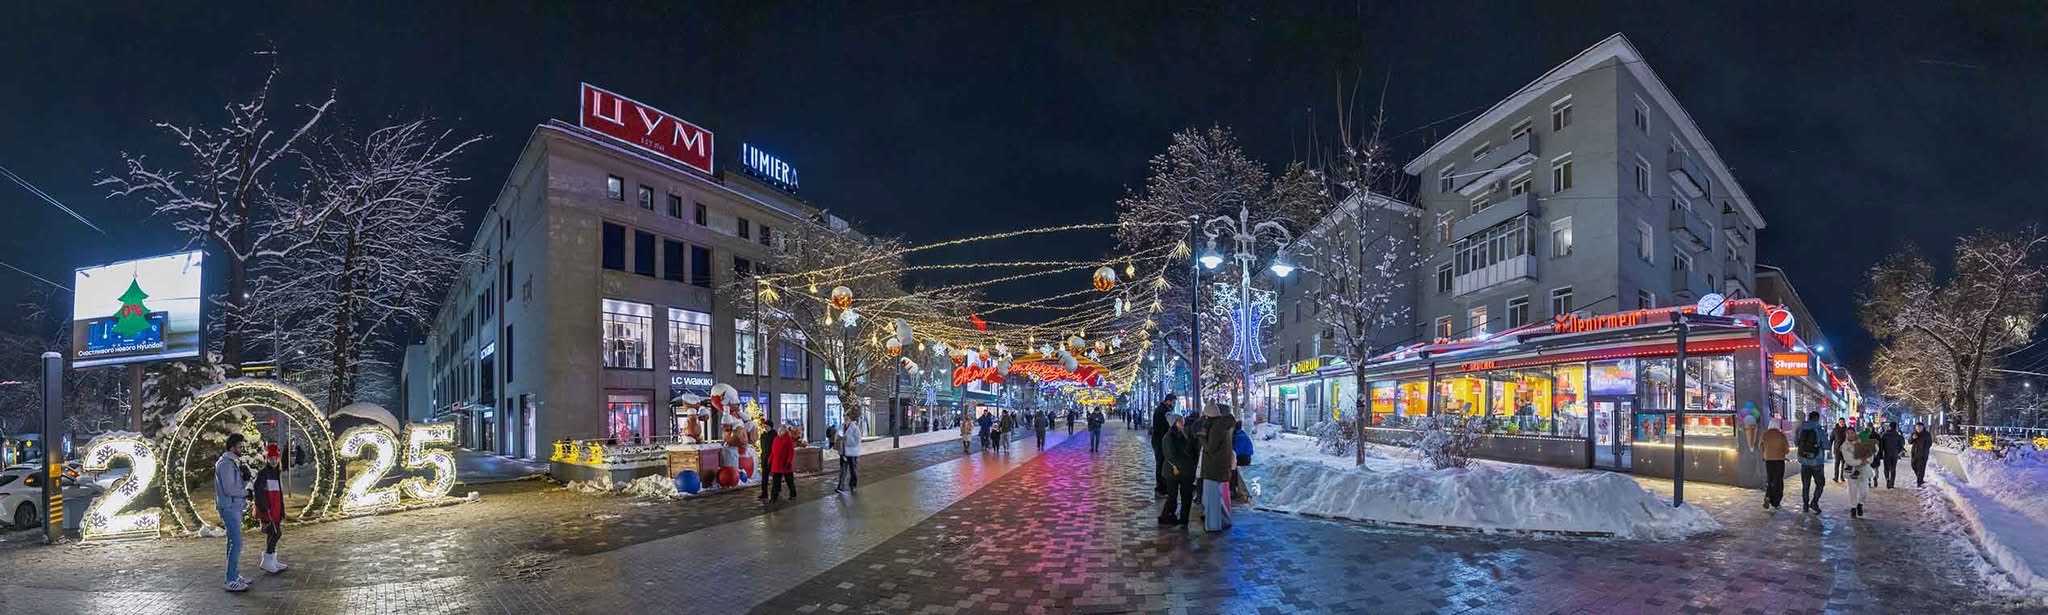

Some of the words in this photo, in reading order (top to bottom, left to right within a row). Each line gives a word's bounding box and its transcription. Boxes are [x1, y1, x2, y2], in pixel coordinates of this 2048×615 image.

[592, 90, 706, 158] ЦУМ
[742, 143, 800, 189] LUMIERA
[671, 376, 684, 385] LC
